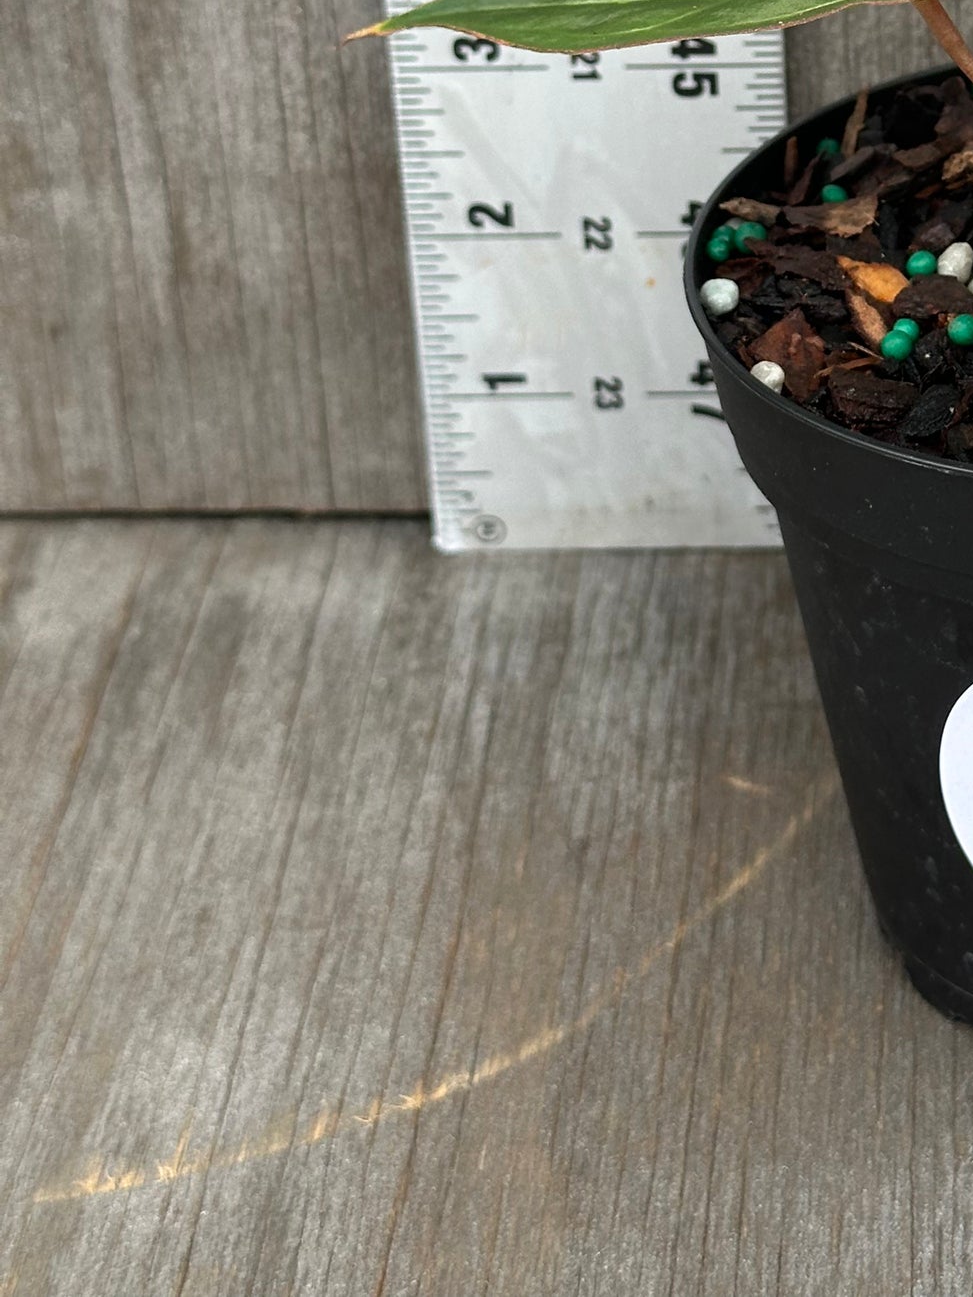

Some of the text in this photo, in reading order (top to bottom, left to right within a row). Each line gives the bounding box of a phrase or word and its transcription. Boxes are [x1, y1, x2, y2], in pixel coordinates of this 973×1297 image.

[453, 37, 500, 62] 3
[571, 52, 601, 82] 21
[671, 38, 720, 98] 45
[468, 201, 514, 228] 2
[582, 216, 611, 252] 22
[483, 371, 526, 390] 1
[593, 376, 622, 410] 23
